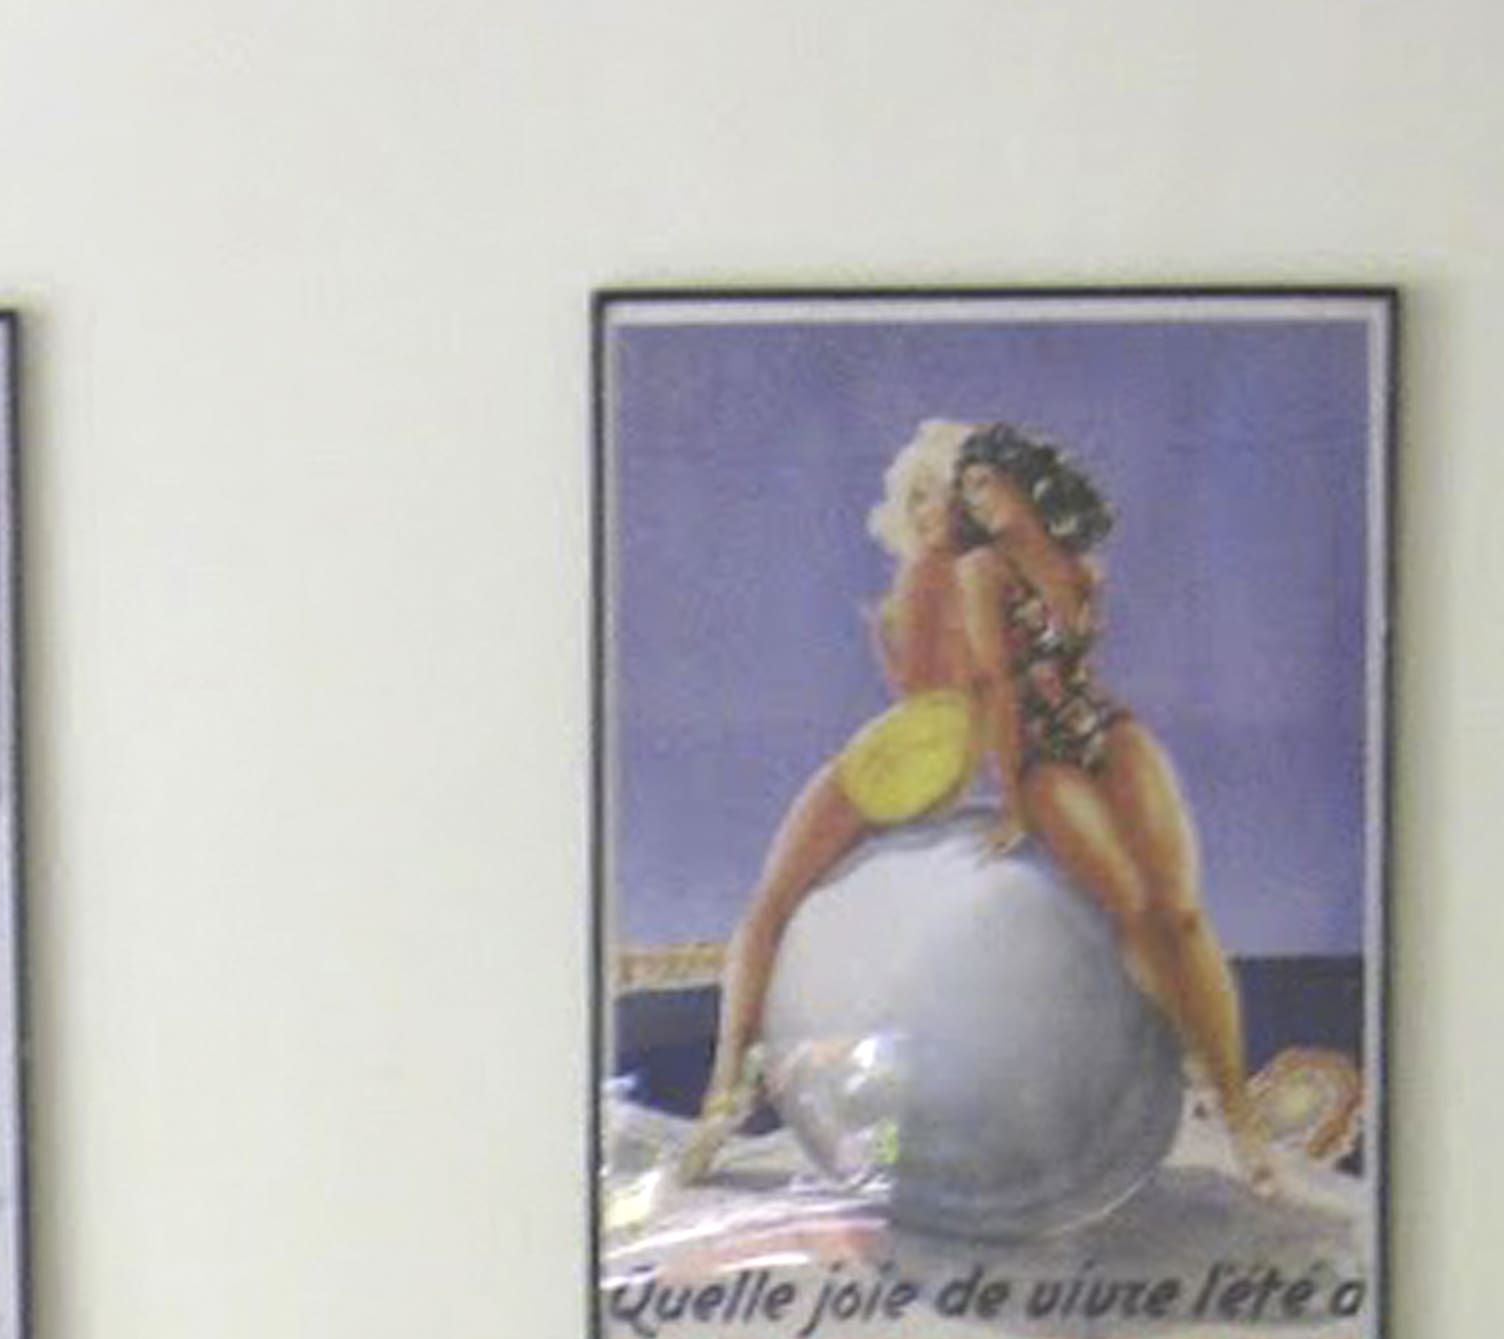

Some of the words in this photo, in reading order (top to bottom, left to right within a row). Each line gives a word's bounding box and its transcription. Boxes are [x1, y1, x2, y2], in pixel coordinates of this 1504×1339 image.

[798, 1260, 920, 1339] joie
[936, 1264, 1010, 1320] de
[1026, 1260, 1180, 1320] vivre
